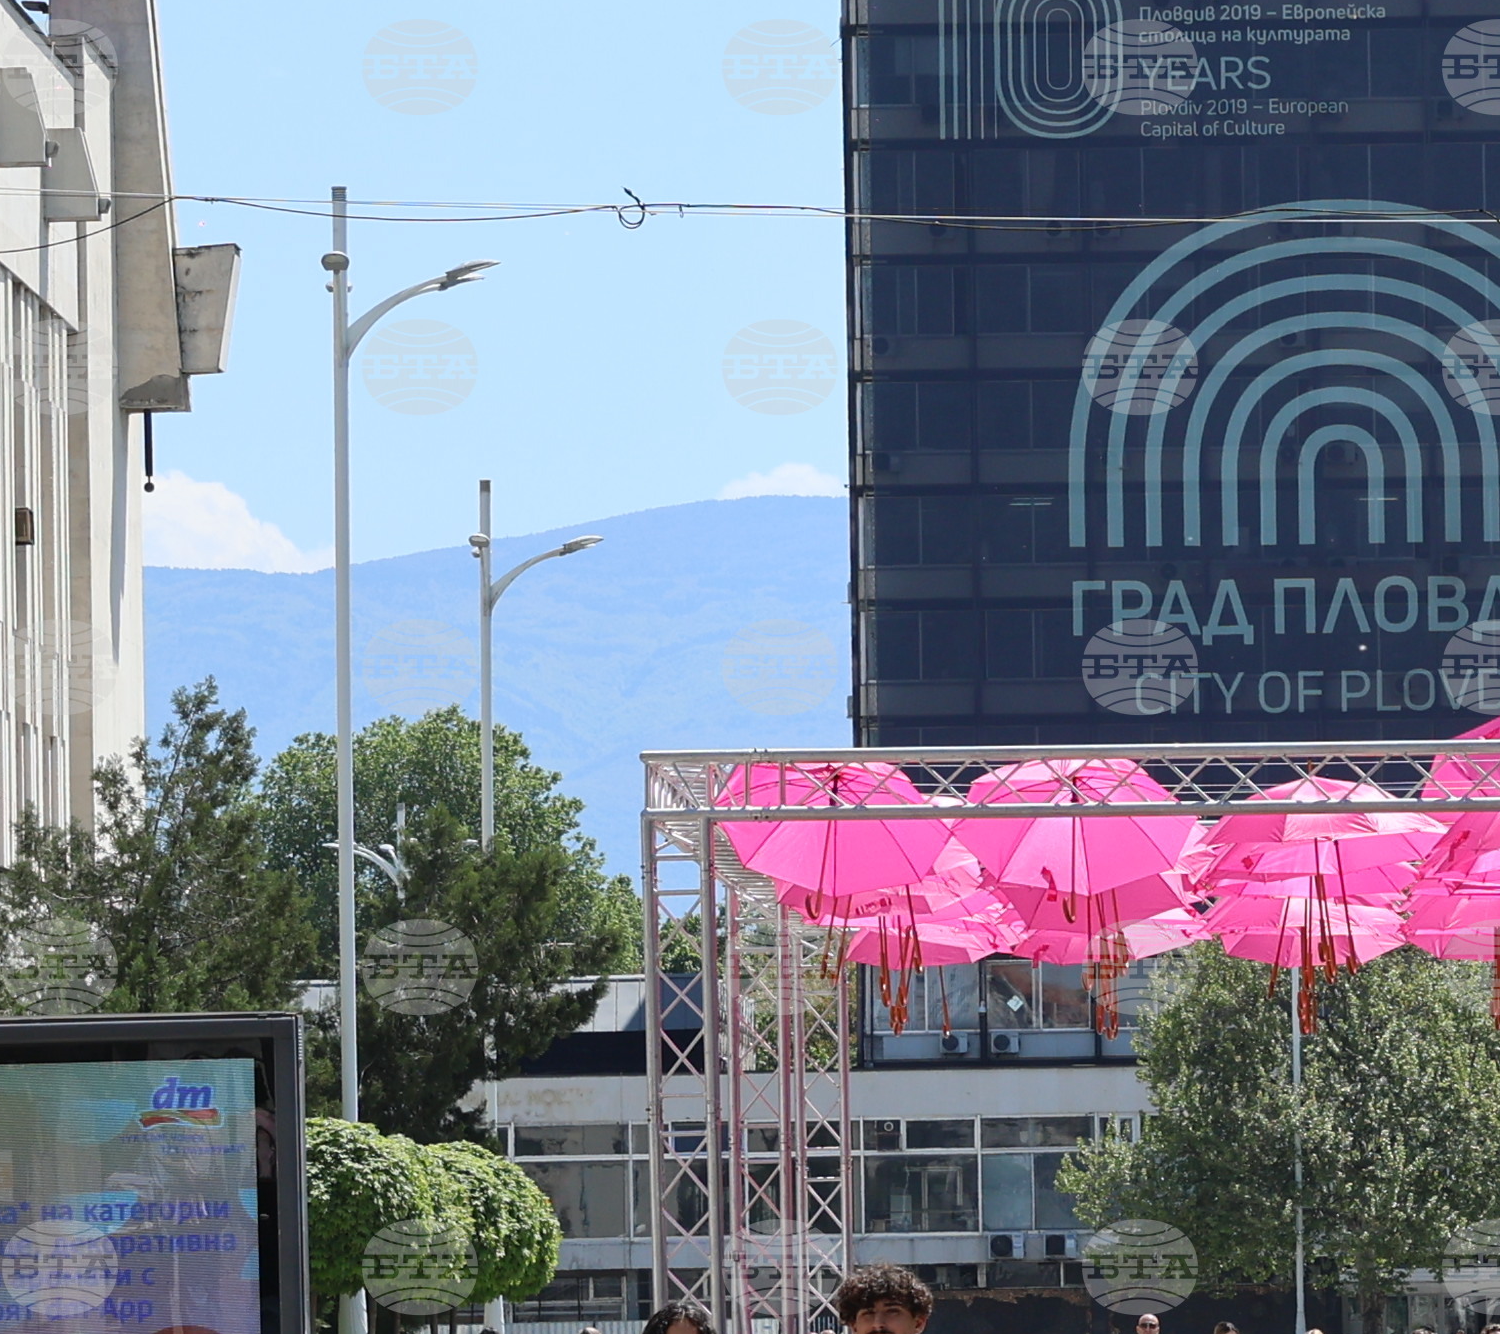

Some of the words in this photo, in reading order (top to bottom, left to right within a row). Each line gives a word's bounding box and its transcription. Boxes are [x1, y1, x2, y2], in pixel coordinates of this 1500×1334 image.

[1139, 6, 1216, 24] Пловдив
[1220, 4, 1261, 21] 2019
[1282, 4, 1386, 23] Европейска
[1139, 29, 1216, 43] столица
[1222, 30, 1242, 42] на
[1247, 26, 1351, 45] културата
[1138, 55, 1271, 91] YEARS
[1140, 99, 1203, 116] Plovdiv
[1206, 99, 1248, 115] 2019
[1269, 98, 1349, 117] European
[1140, 121, 1199, 140] Capital
[1202, 120, 1219, 136] of
[1223, 120, 1285, 136] Culture
[1070, 577, 1254, 646] ГРАД
[1133, 670, 1249, 715] CITY
[1258, 669, 1325, 713] OF
[152, 1076, 212, 1109] dm
[41, 1204, 73, 1221] на
[84, 1200, 229, 1225] категории
[104, 1298, 154, 1324] App
